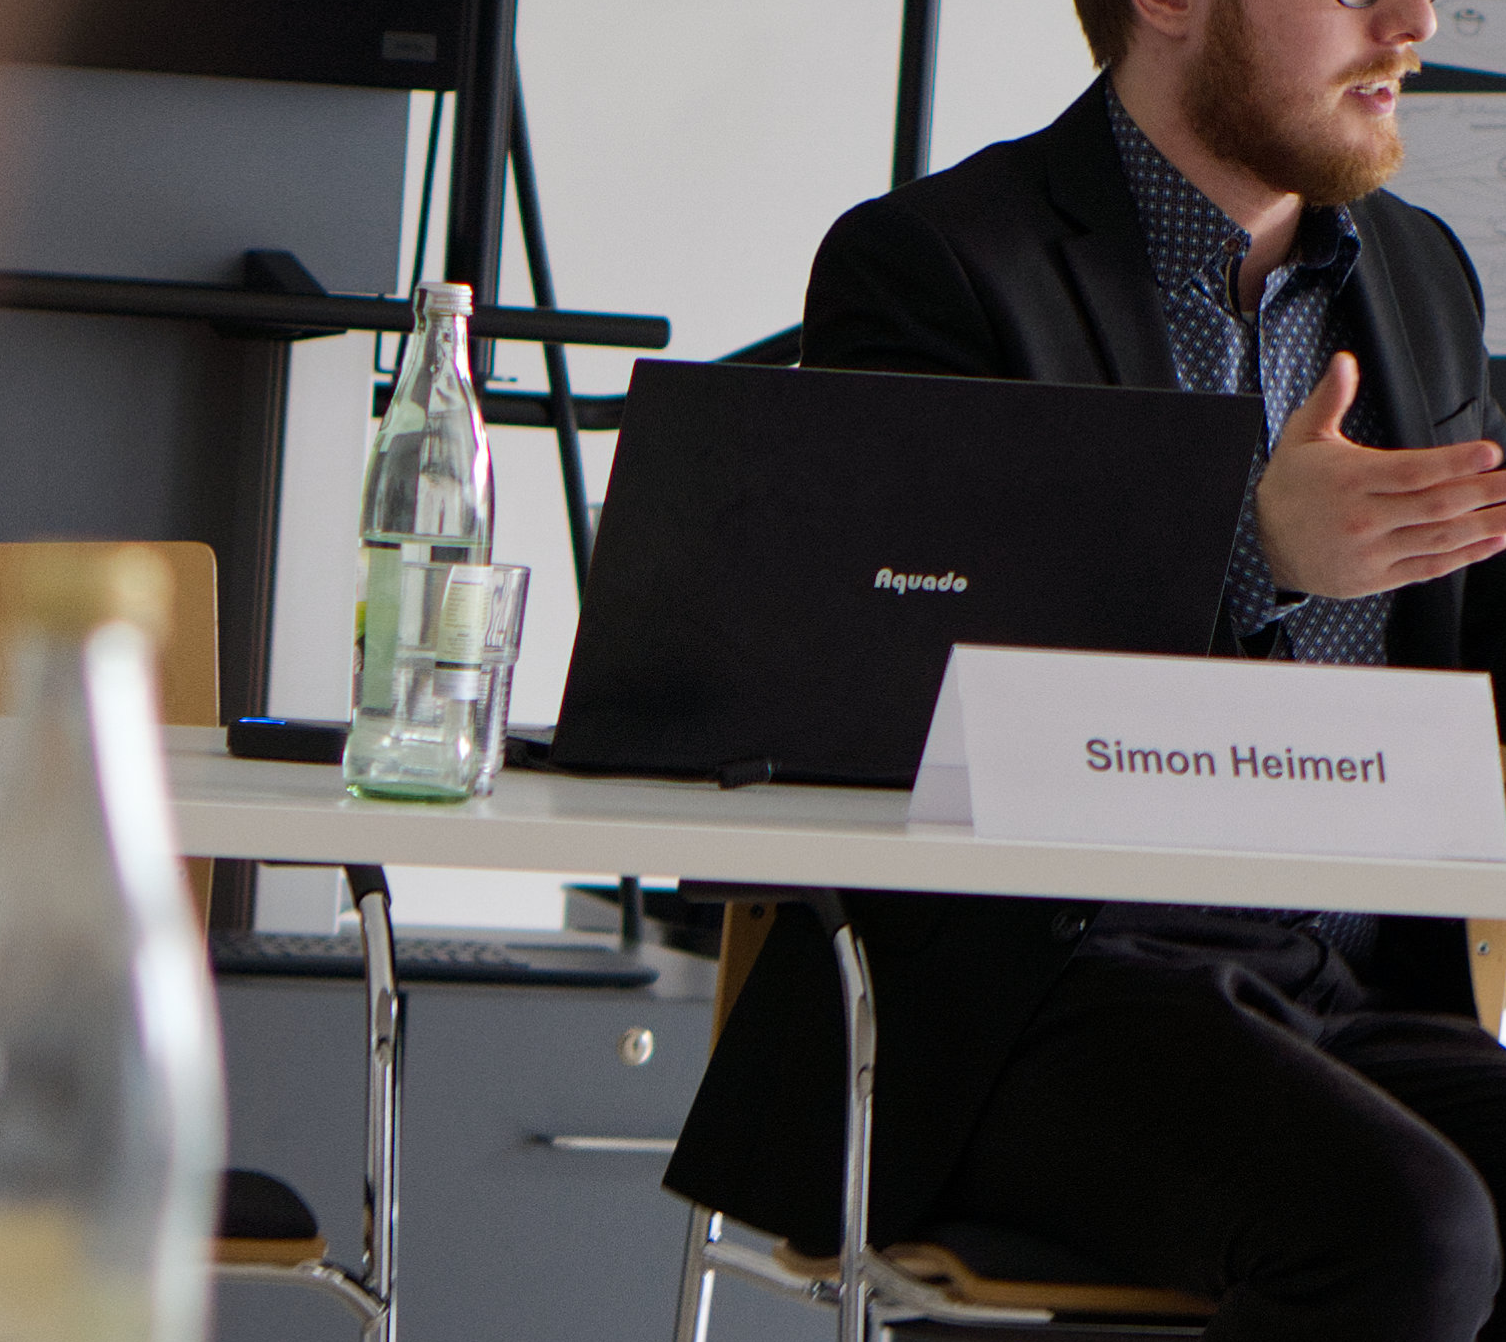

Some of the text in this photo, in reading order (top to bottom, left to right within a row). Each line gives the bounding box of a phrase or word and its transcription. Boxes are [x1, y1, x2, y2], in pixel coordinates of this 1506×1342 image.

[875, 568, 967, 594] Aquado
[1086, 739, 1385, 782] Simon Heimerl
